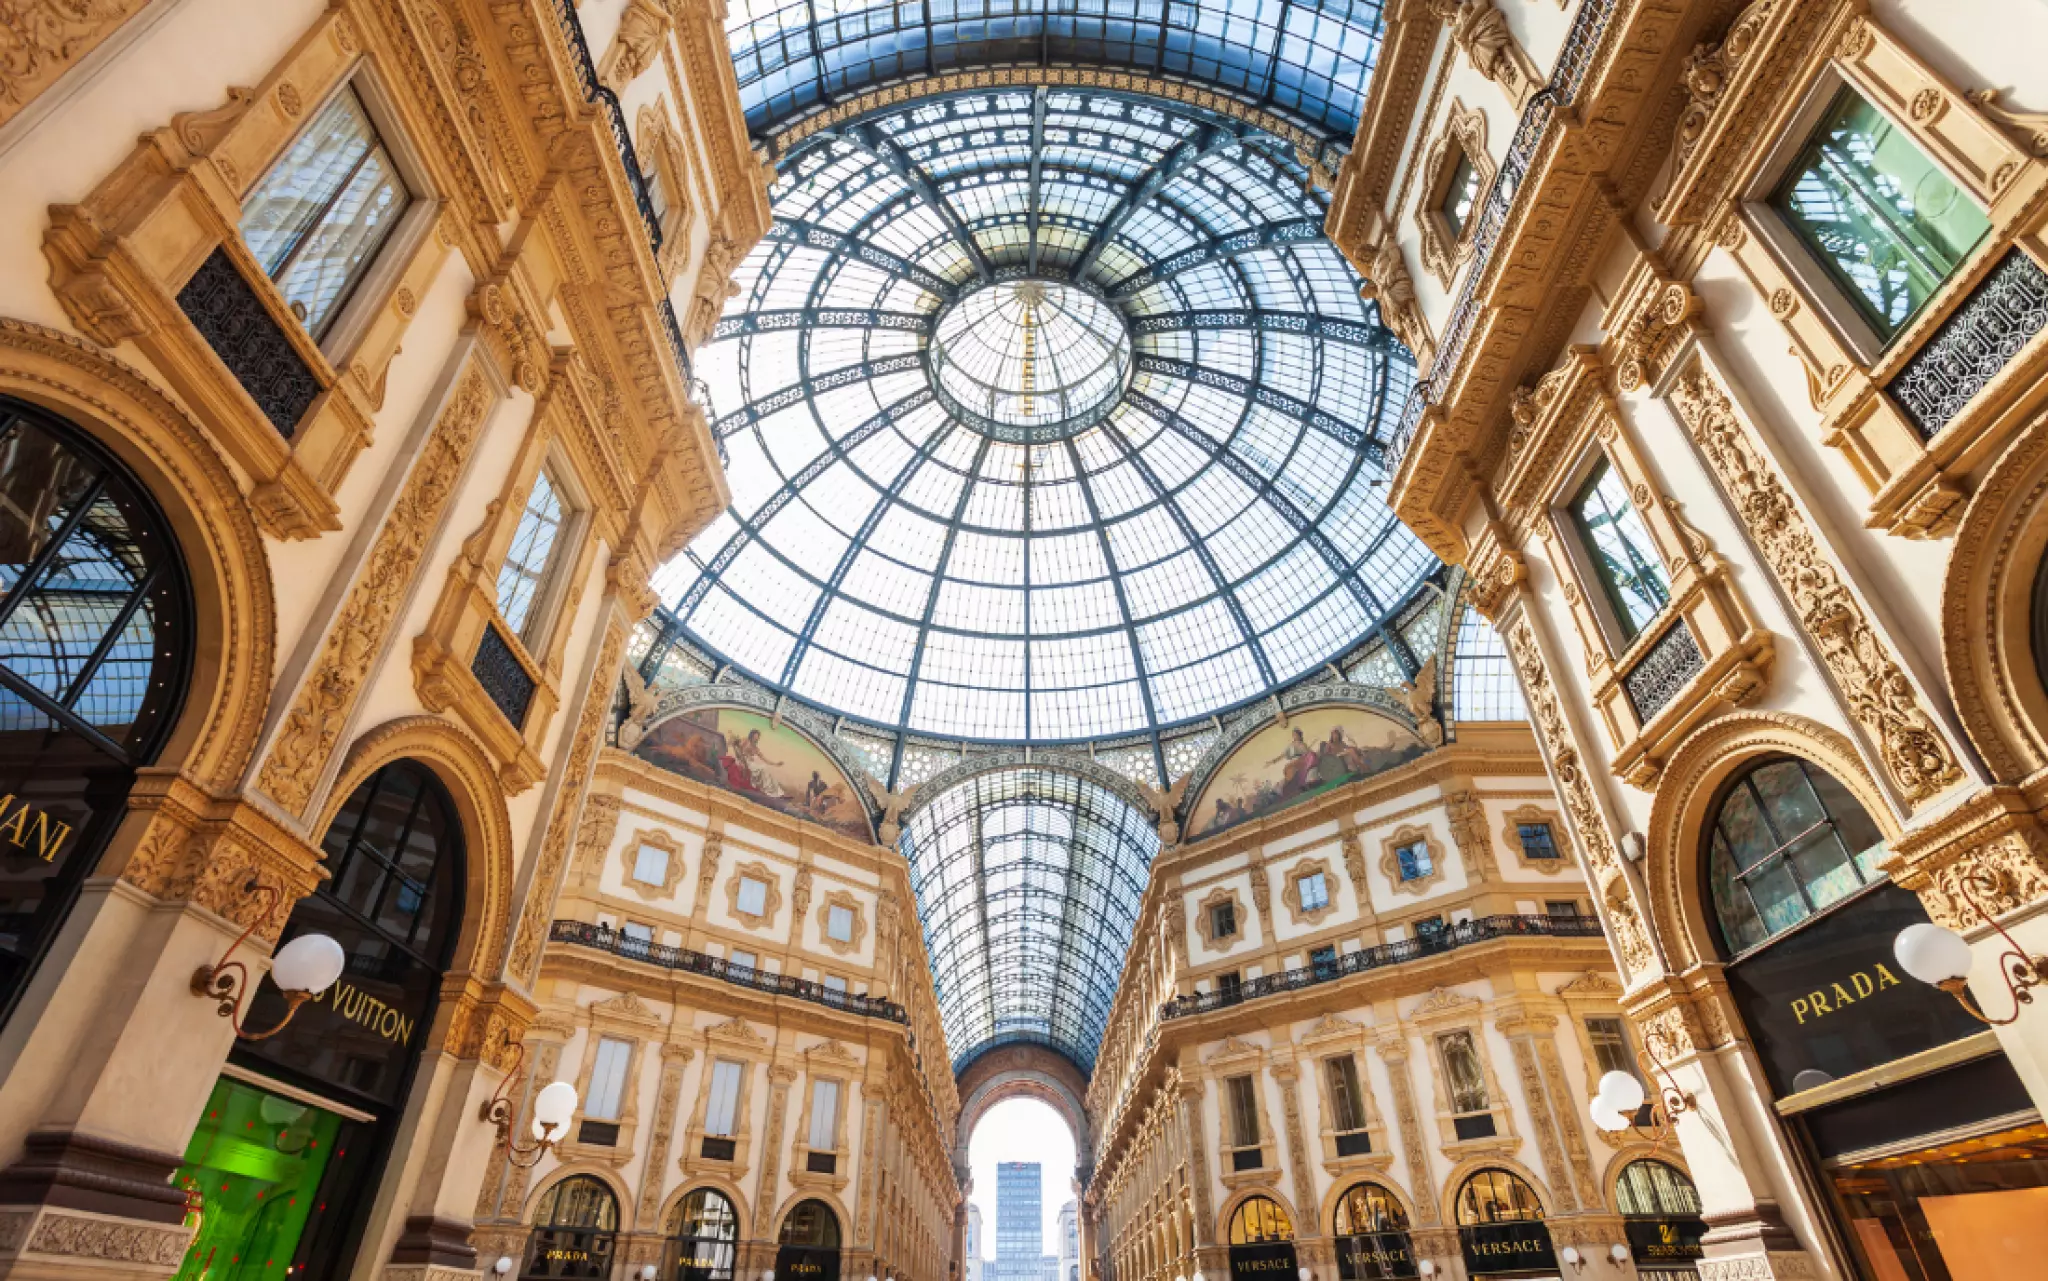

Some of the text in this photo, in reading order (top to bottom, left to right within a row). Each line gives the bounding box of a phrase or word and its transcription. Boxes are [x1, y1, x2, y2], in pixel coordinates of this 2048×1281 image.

[1790, 962, 1901, 1025] PRADA
[332, 979, 414, 1047] VUITTON
[546, 1249, 588, 1262] PRADA
[1471, 1239, 1543, 1256] VERSACE
[1344, 1249, 1408, 1265] VERSACE
[1237, 1258, 1290, 1273] VERSACE
